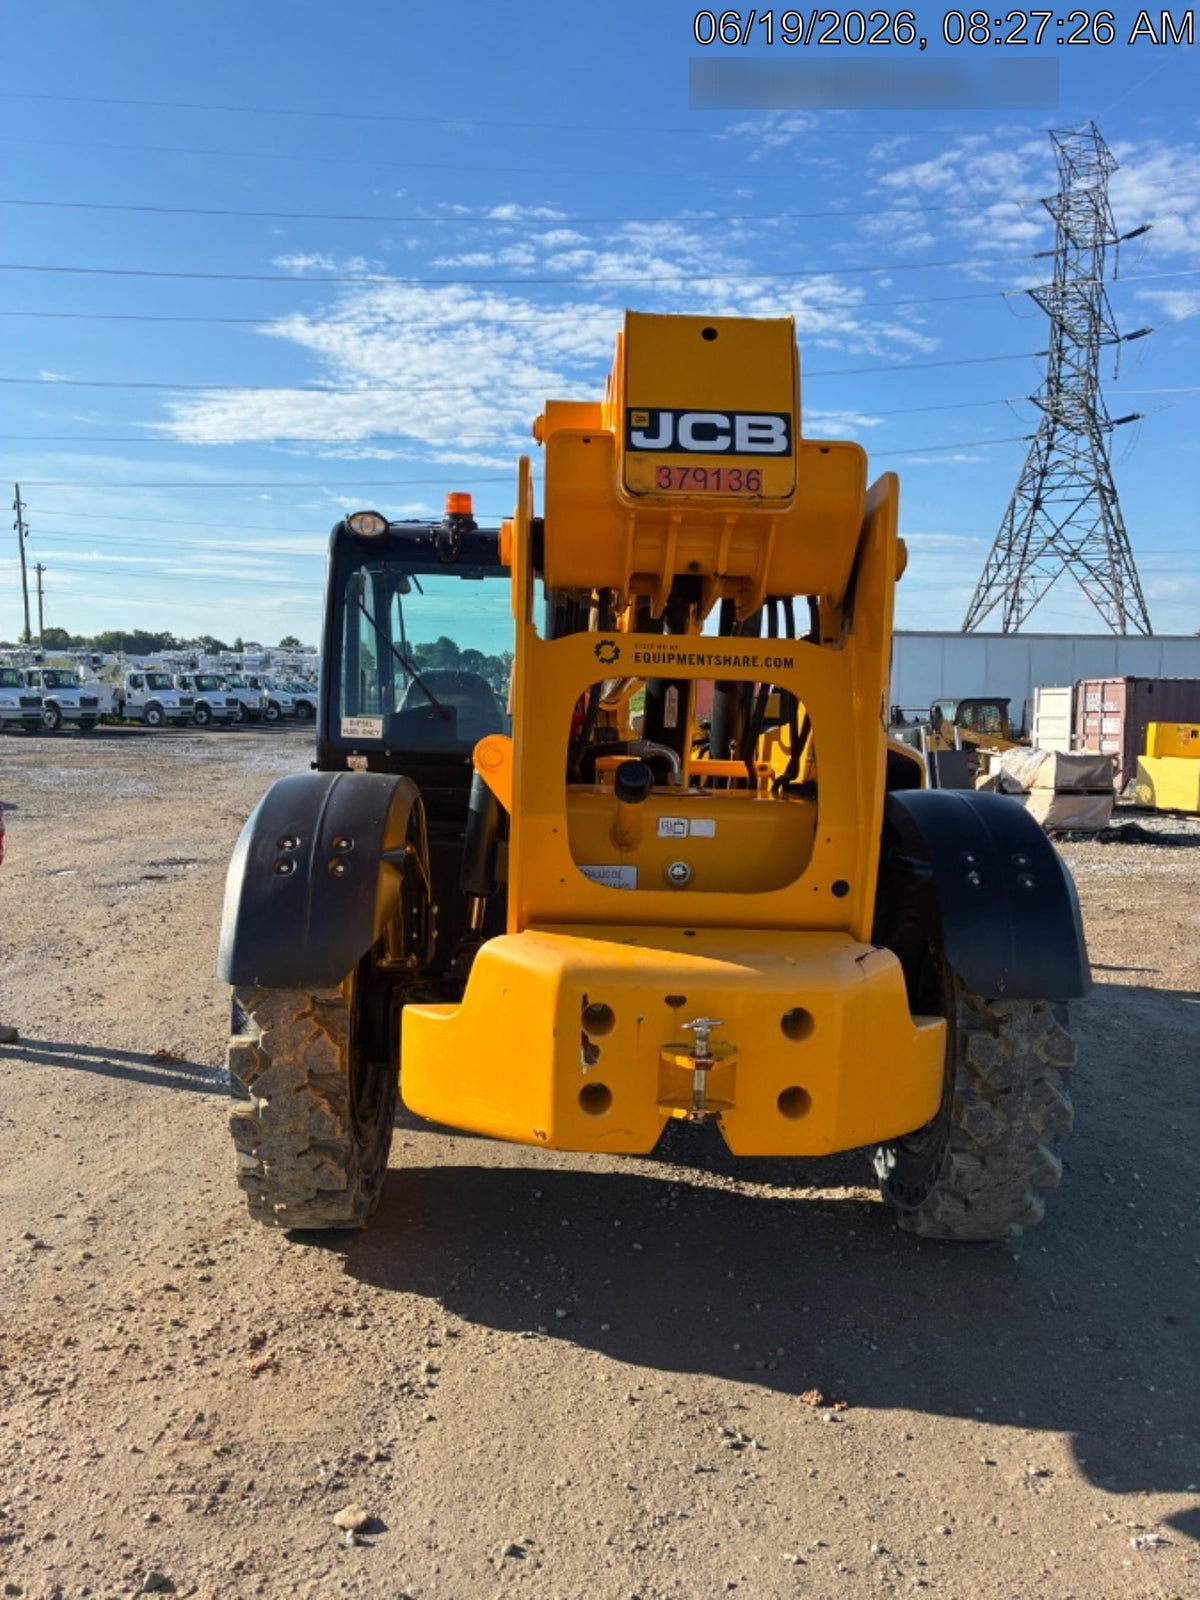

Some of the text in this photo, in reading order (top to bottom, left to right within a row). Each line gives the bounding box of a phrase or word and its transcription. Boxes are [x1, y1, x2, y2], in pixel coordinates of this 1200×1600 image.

[630, 411, 788, 453] JCB
[657, 466, 762, 492] 379136
[634, 652, 794, 668] EQUIPMENTSHARE.COM
